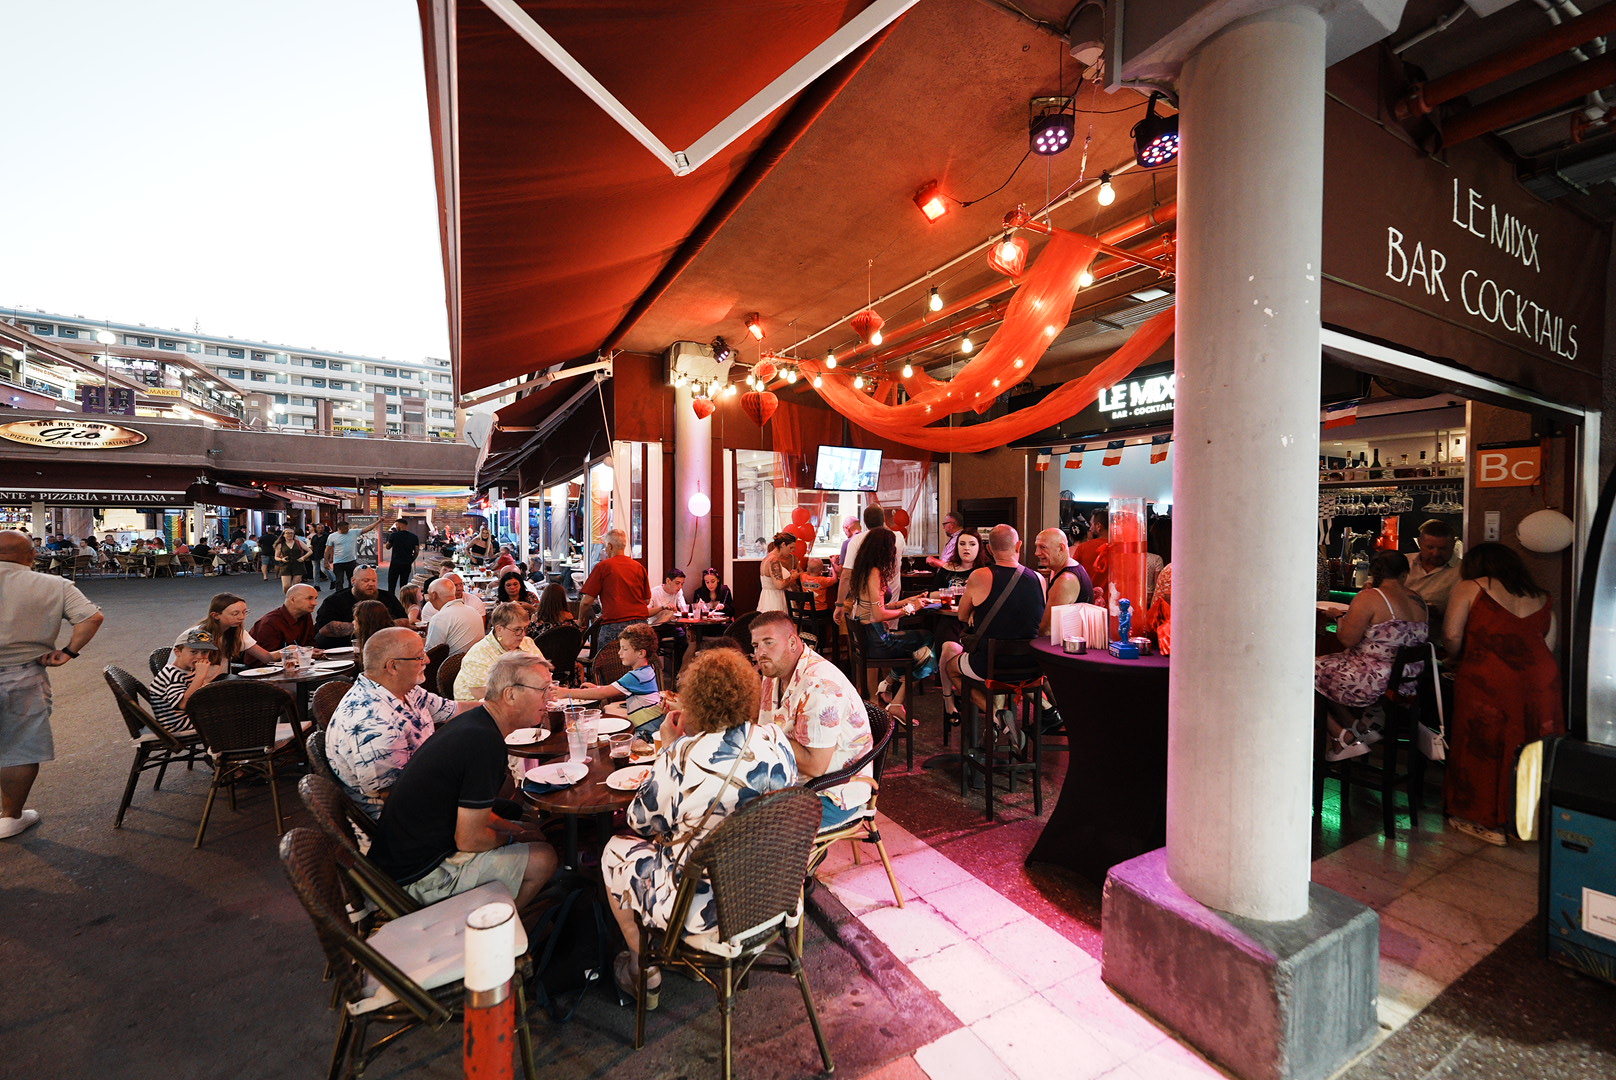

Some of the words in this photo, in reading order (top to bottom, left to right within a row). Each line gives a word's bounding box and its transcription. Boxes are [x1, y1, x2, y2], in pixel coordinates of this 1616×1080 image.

[1453, 178, 1486, 239] LE
[1490, 203, 1541, 273] MIXX
[1385, 226, 1450, 302] BAR
[1460, 269, 1578, 361] COCKTAILS
[1098, 384, 1127, 412] LE
[1112, 410, 1128, 419] BAR
[39, 427, 101, 442] Gio
[1480, 453, 1534, 482] Bc
[39, 492, 99, 501] PIZZERÍA
